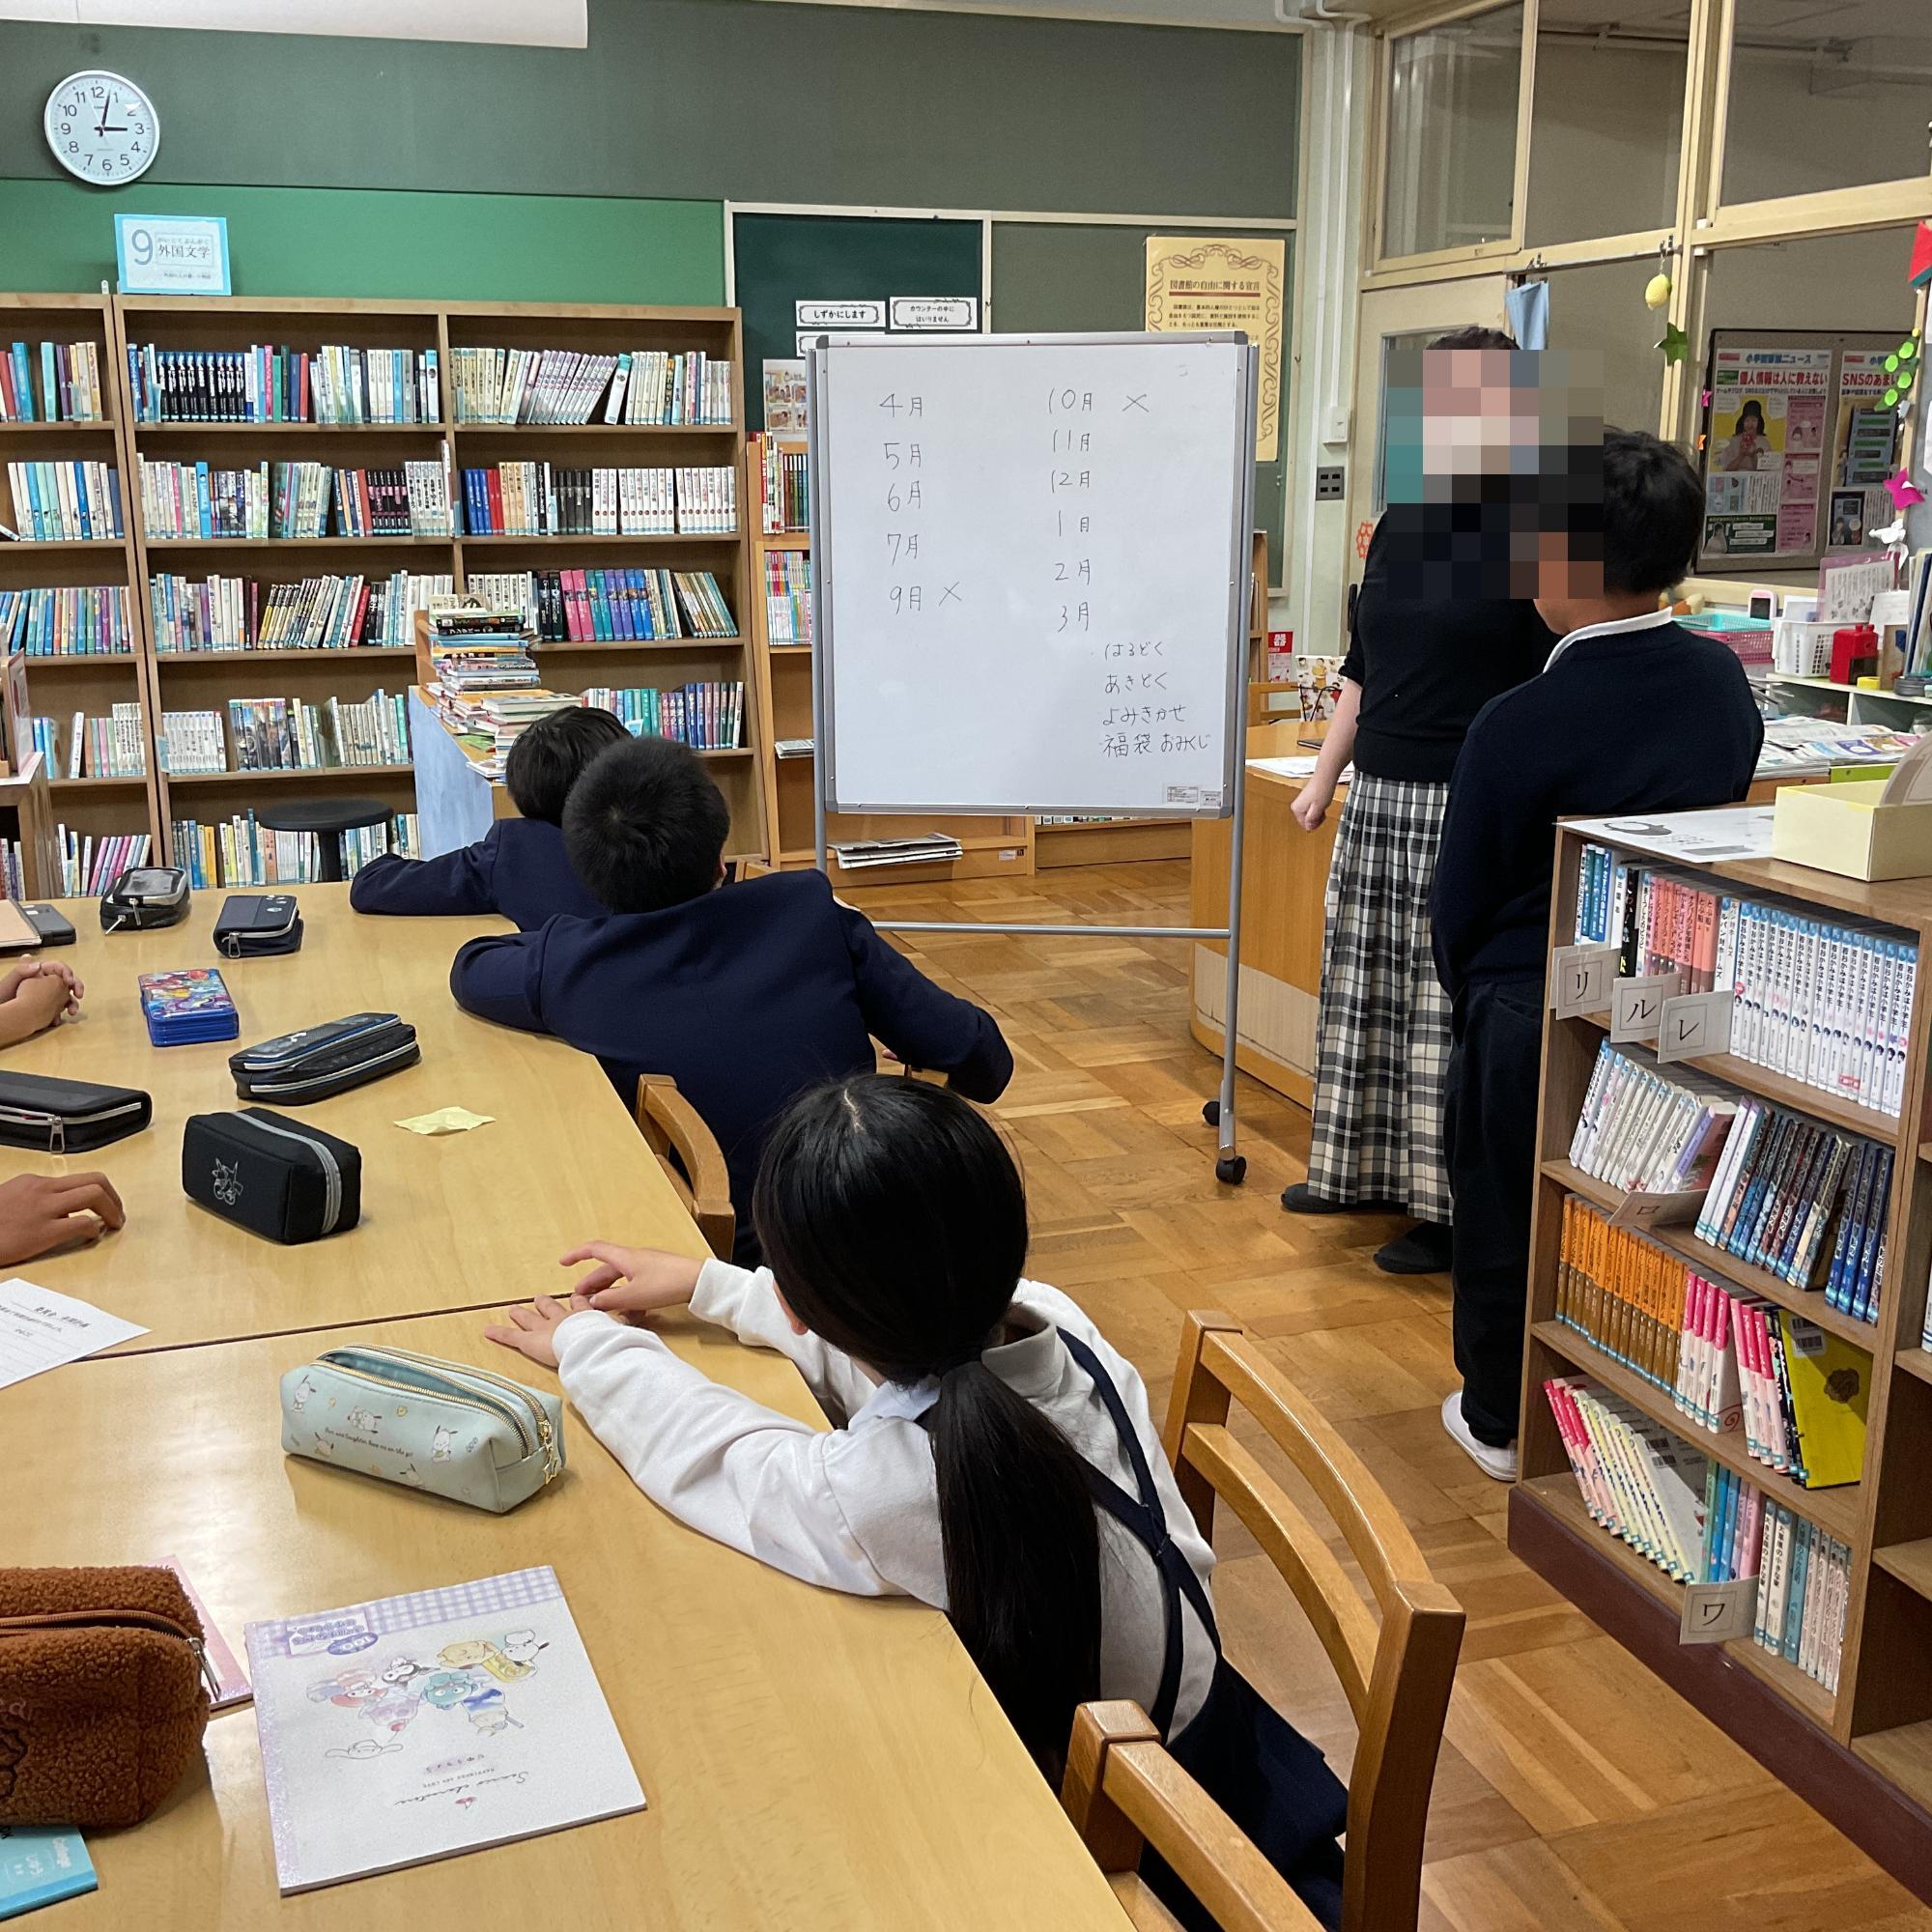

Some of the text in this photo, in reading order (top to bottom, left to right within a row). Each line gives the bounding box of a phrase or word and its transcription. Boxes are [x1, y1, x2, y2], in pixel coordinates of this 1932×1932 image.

[75, 91, 86, 103] 11
[91, 86, 104, 99] 12
[113, 92, 119, 103] 1
[63, 103, 77, 117] 10
[61, 123, 71, 134] 9
[134, 123, 145, 134] 3
[69, 141, 79, 153] 8
[130, 141, 141, 153] 4
[84, 154, 94, 166] 7
[101, 158, 113, 171] 6
[120, 154, 129, 166] 5
[131, 229, 154, 266] 9
[158, 244, 211, 259] 外国文学
[1170, 279, 1260, 291] 図書館の自由に関する宣言
[813, 309, 867, 320] しずかにします
[1740, 370, 1829, 386] 個人情報は人に教えない
[878, 393, 923, 418] 4月
[1047, 388, 1093, 413] 10月
[1052, 429, 1091, 454] 11月
[883, 441, 922, 470] 5月
[1050, 469, 1091, 494] 12月
[887, 479, 922, 512] 6月
[1058, 509, 1090, 537] 1月
[887, 533, 919, 566] 7月
[1054, 558, 1091, 585] 2月
[889, 585, 922, 615] 9月
[1057, 601, 1090, 633] 3月
[1104, 641, 1164, 661] はるどく
[1104, 671, 1169, 695] あきどく
[1102, 704, 1187, 727] よみきかせ
[1102, 731, 1211, 758] 福袋 おみくじ
[1716, 913, 1729, 980] ルパン対ホームズ
[1576, 971, 1589, 1000] リ
[1626, 998, 1657, 1023] ル
[1678, 1016, 1700, 1042] レ
[1758, 1516, 1773, 1587] 大きな森の小さな家
[1772, 1524, 1786, 1588] 大草原の小さな家
[393, 1771, 529, 1807] Sanrio characters
